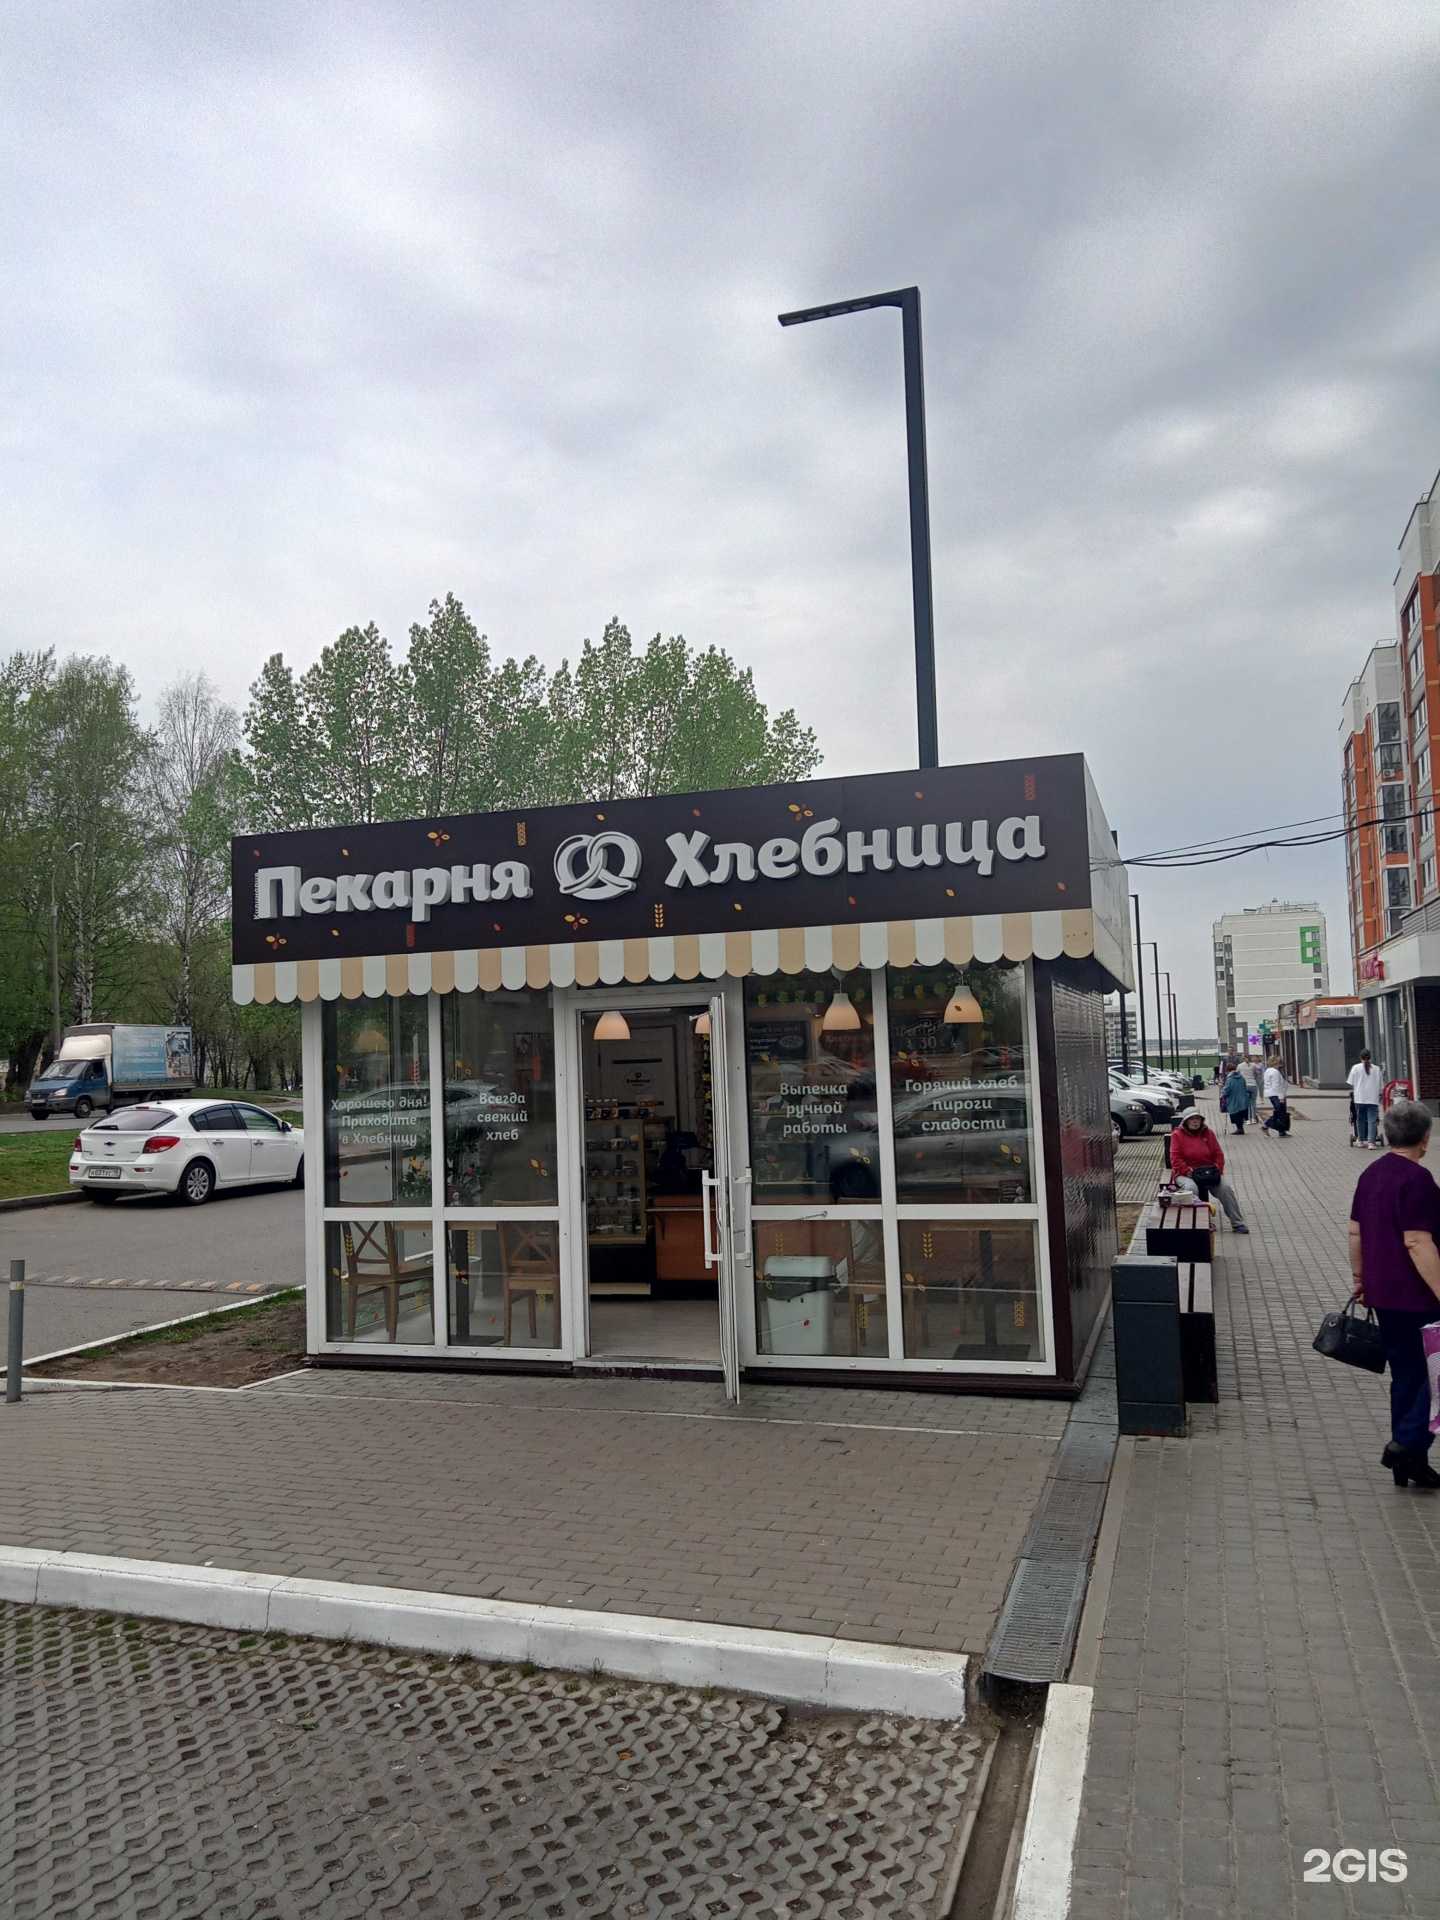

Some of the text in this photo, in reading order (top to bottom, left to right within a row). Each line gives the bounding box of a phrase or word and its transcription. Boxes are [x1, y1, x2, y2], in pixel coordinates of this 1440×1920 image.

[257, 860, 533, 922] Пекарня
[664, 815, 1046, 888] Хлебница
[780, 1082, 848, 1096] Выпечка
[904, 1075, 1018, 1095] Горячий хлеб
[331, 1096, 427, 1112] Хорошего дня!
[480, 1092, 526, 1105] Всегда
[786, 1101, 843, 1118] ручной
[932, 1099, 993, 1114] пироги
[342, 1114, 417, 1129] Приходите
[477, 1110, 528, 1122] свежий
[783, 1121, 848, 1138] работы
[921, 1117, 1007, 1131] сладости
[353, 1132, 417, 1147] Хлебницу
[486, 1128, 519, 1141] хлеб
